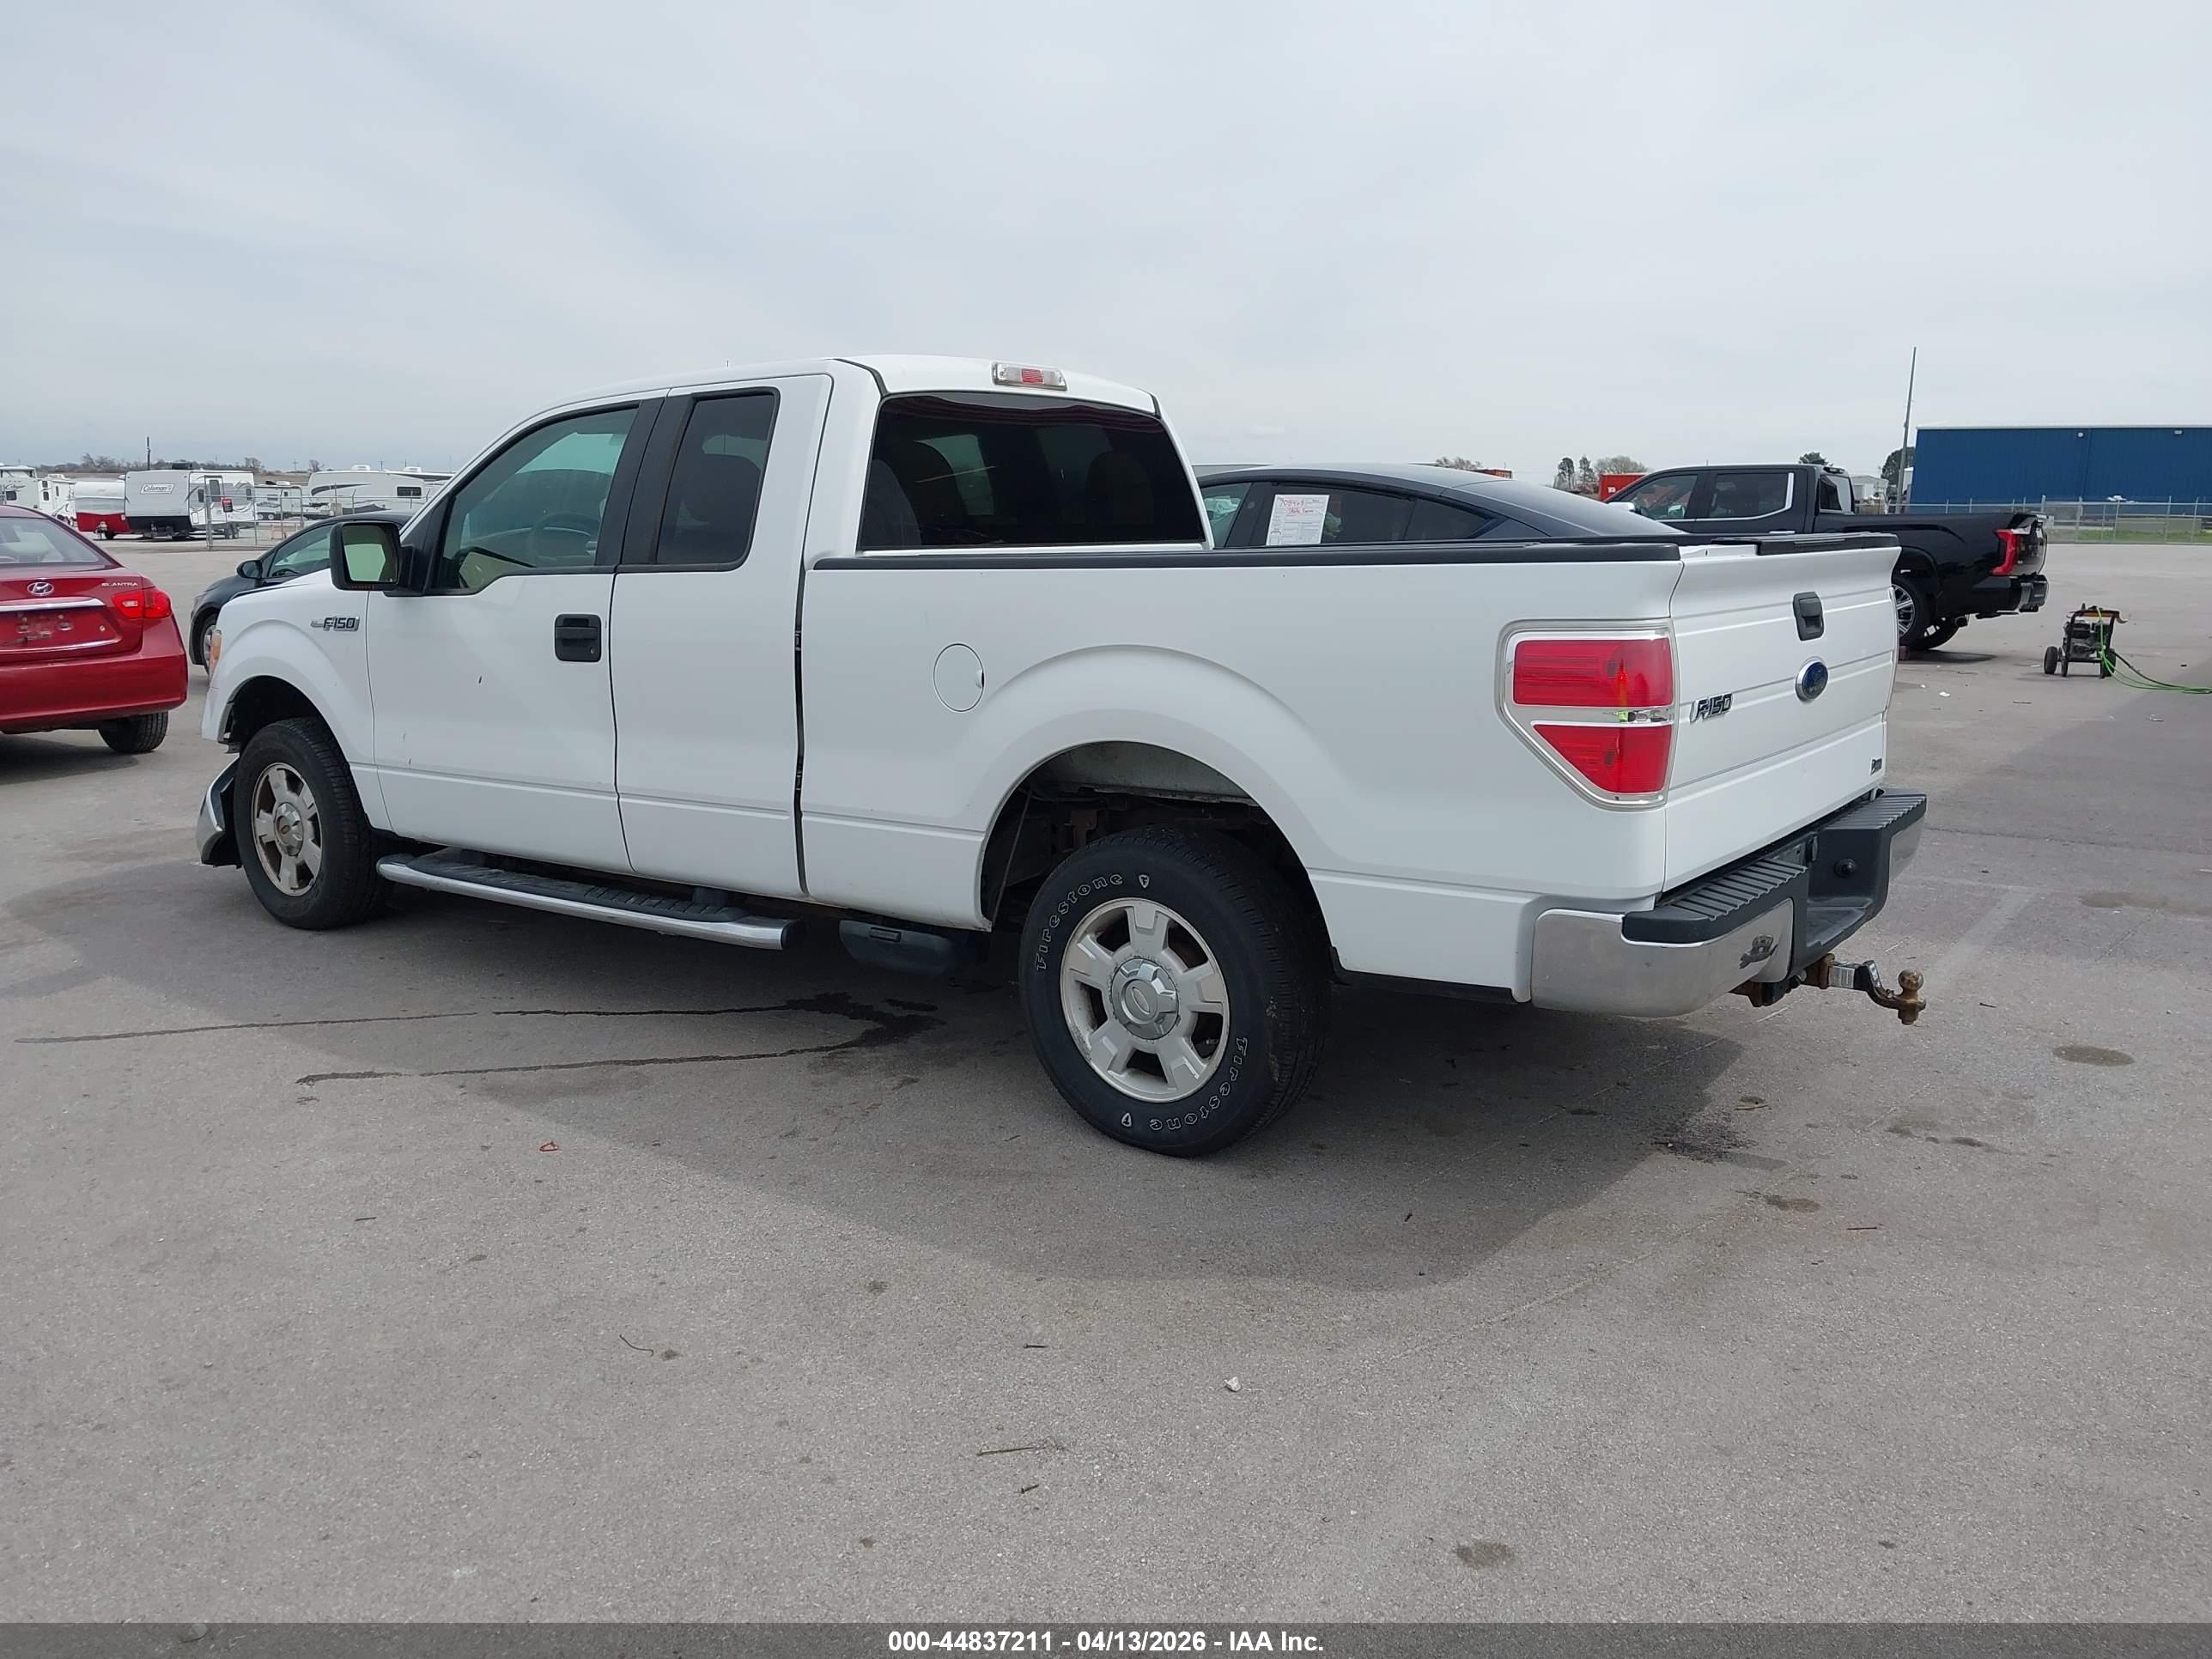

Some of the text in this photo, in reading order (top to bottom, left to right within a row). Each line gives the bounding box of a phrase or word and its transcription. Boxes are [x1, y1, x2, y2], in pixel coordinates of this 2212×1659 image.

[143, 484, 167, 493] Coleman
[1035, 873, 1123, 971] Firestone
[1149, 1036, 1249, 1131] Firestone
